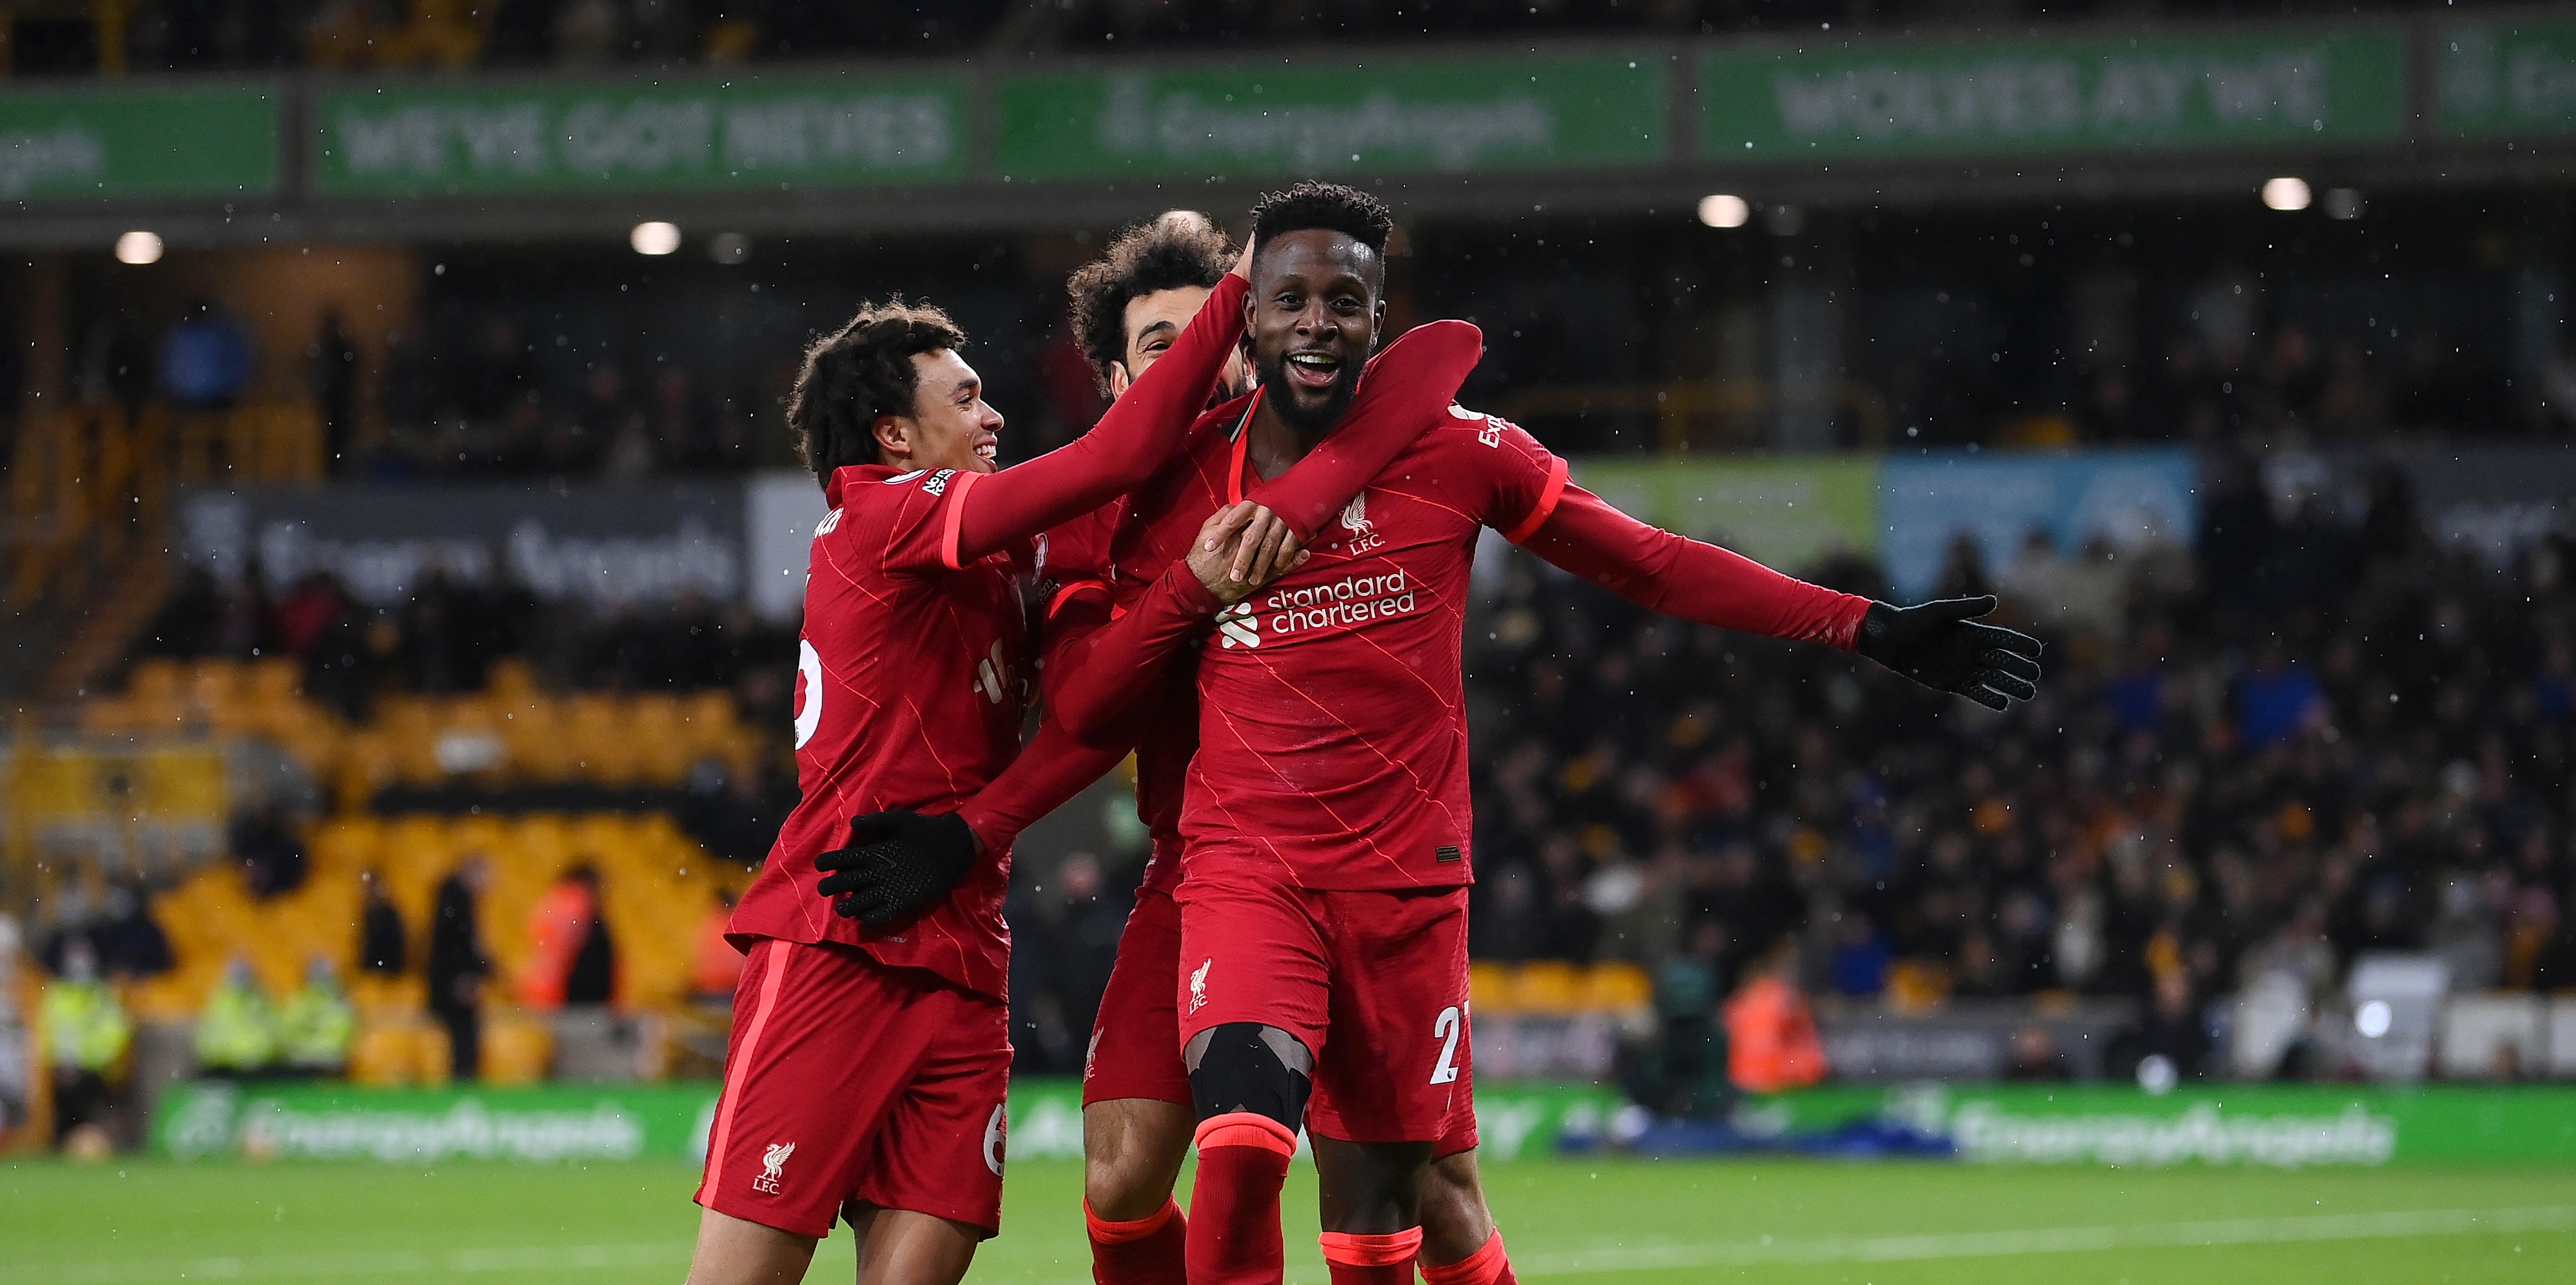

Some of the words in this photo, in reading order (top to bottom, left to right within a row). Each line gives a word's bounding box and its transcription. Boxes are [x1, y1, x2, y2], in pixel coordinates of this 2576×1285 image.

[1776, 67, 2078, 134] WOLVES
[560, 97, 711, 170] GOT
[922, 477, 940, 493] No
[1267, 568, 1405, 612] standard
[1272, 590, 1415, 634] chartered
[1429, 1000, 1469, 1085] 2
